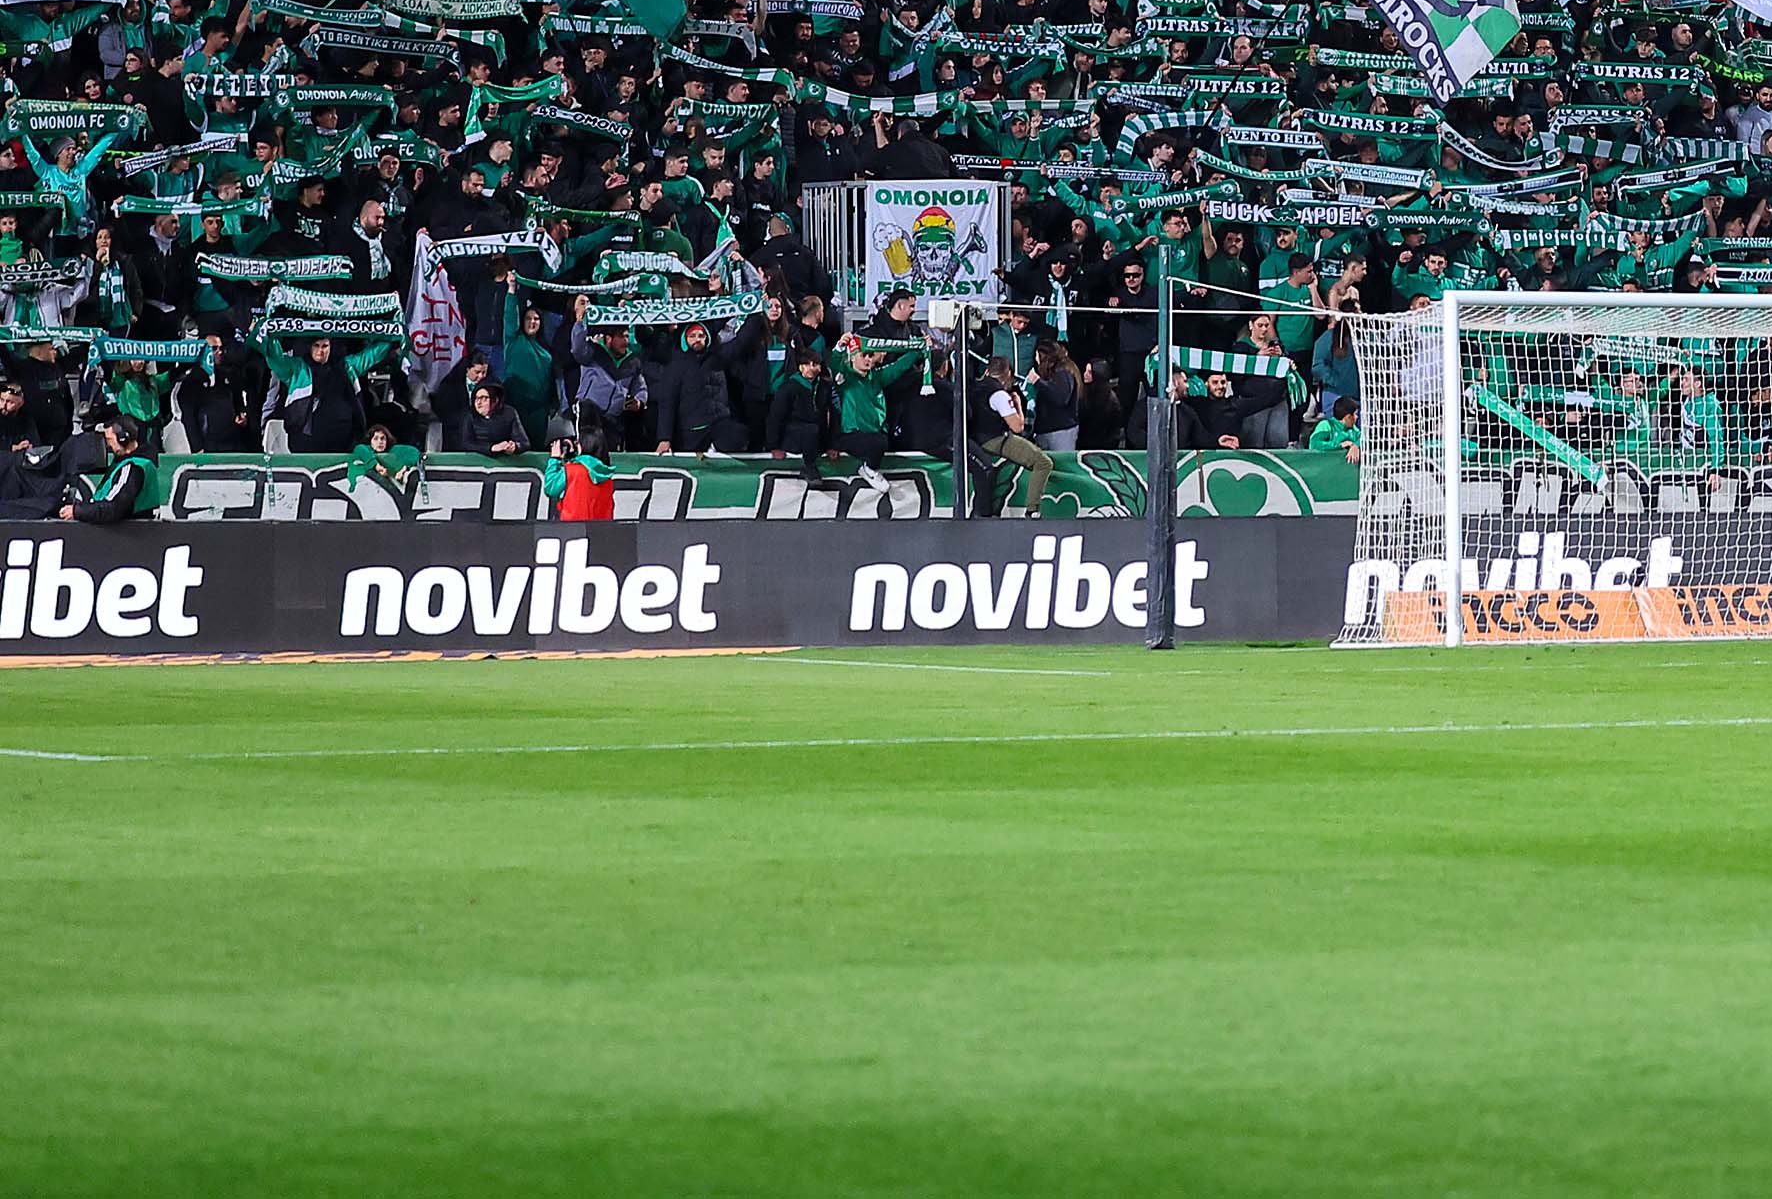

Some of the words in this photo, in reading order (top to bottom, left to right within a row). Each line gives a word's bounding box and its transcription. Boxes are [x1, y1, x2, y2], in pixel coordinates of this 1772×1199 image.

[1147, 19, 1209, 33] ULTRAS
[322, 30, 334, 43] ΤΟ
[392, 39, 413, 54] ΤΗΣ
[413, 41, 454, 58] ΚΥΠΡΟΥ
[1593, 64, 1664, 79] ULTRAS
[1670, 66, 1691, 80] 12
[1713, 62, 1765, 83] YEARS
[296, 89, 347, 101] OMONOIA
[1263, 80, 1281, 95] 12
[29, 113, 87, 130] OMONOIA
[89, 112, 105, 128] FC
[1318, 111, 1385, 133] ULTRAS
[1389, 118, 1410, 133] 12
[1263, 132, 1281, 145] TO
[1285, 133, 1320, 146] HELL
[399, 143, 415, 156] FC
[875, 189, 989, 206] OMONOIA
[1138, 194, 1193, 210] OMONOIA
[1195, 188, 1210, 201] FC
[1209, 200, 1269, 223] FUCK
[1301, 207, 1362, 226] APOEL
[1386, 213, 1437, 224] OMONOIA
[265, 317, 305, 333] SF48
[320, 318, 402, 335] OMONOIA
[103, 343, 166, 360] OMONOIA
[0, 539, 203, 640] ibet
[341, 538, 720, 637] novibet
[849, 535, 1209, 631] novibet
